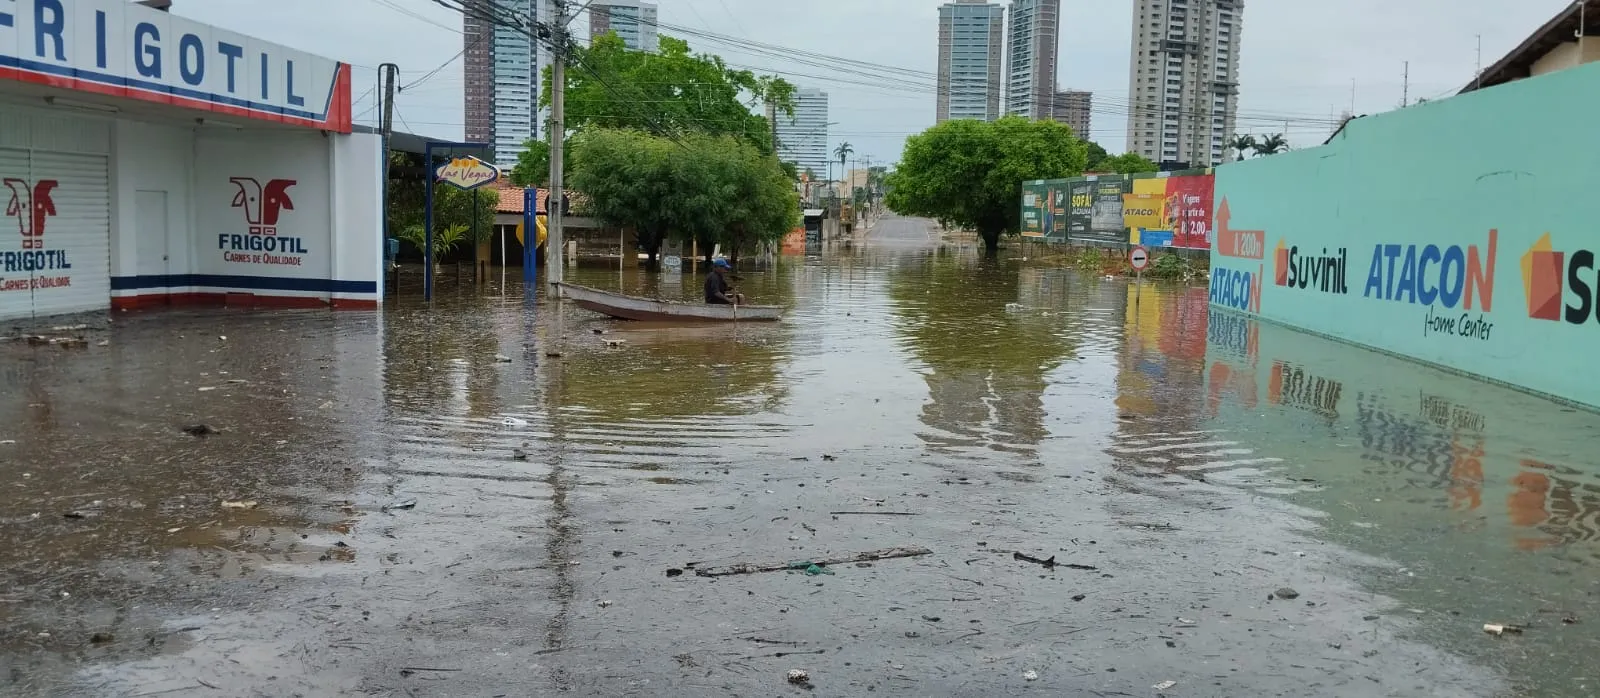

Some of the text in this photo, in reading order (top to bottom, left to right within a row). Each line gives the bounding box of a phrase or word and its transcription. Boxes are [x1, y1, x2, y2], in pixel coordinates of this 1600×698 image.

[436, 165, 494, 183] Las Vegas
[1124, 207, 1160, 217] ATACON
[218, 233, 308, 254] FRIGOTIL
[1233, 231, 1239, 256] A
[1209, 263, 1264, 313] ATACON
[1287, 245, 1348, 295] Suvinil
[1364, 228, 1498, 313] ATACON
[1565, 249, 1600, 325] S
[1424, 304, 1494, 341] Home Center
